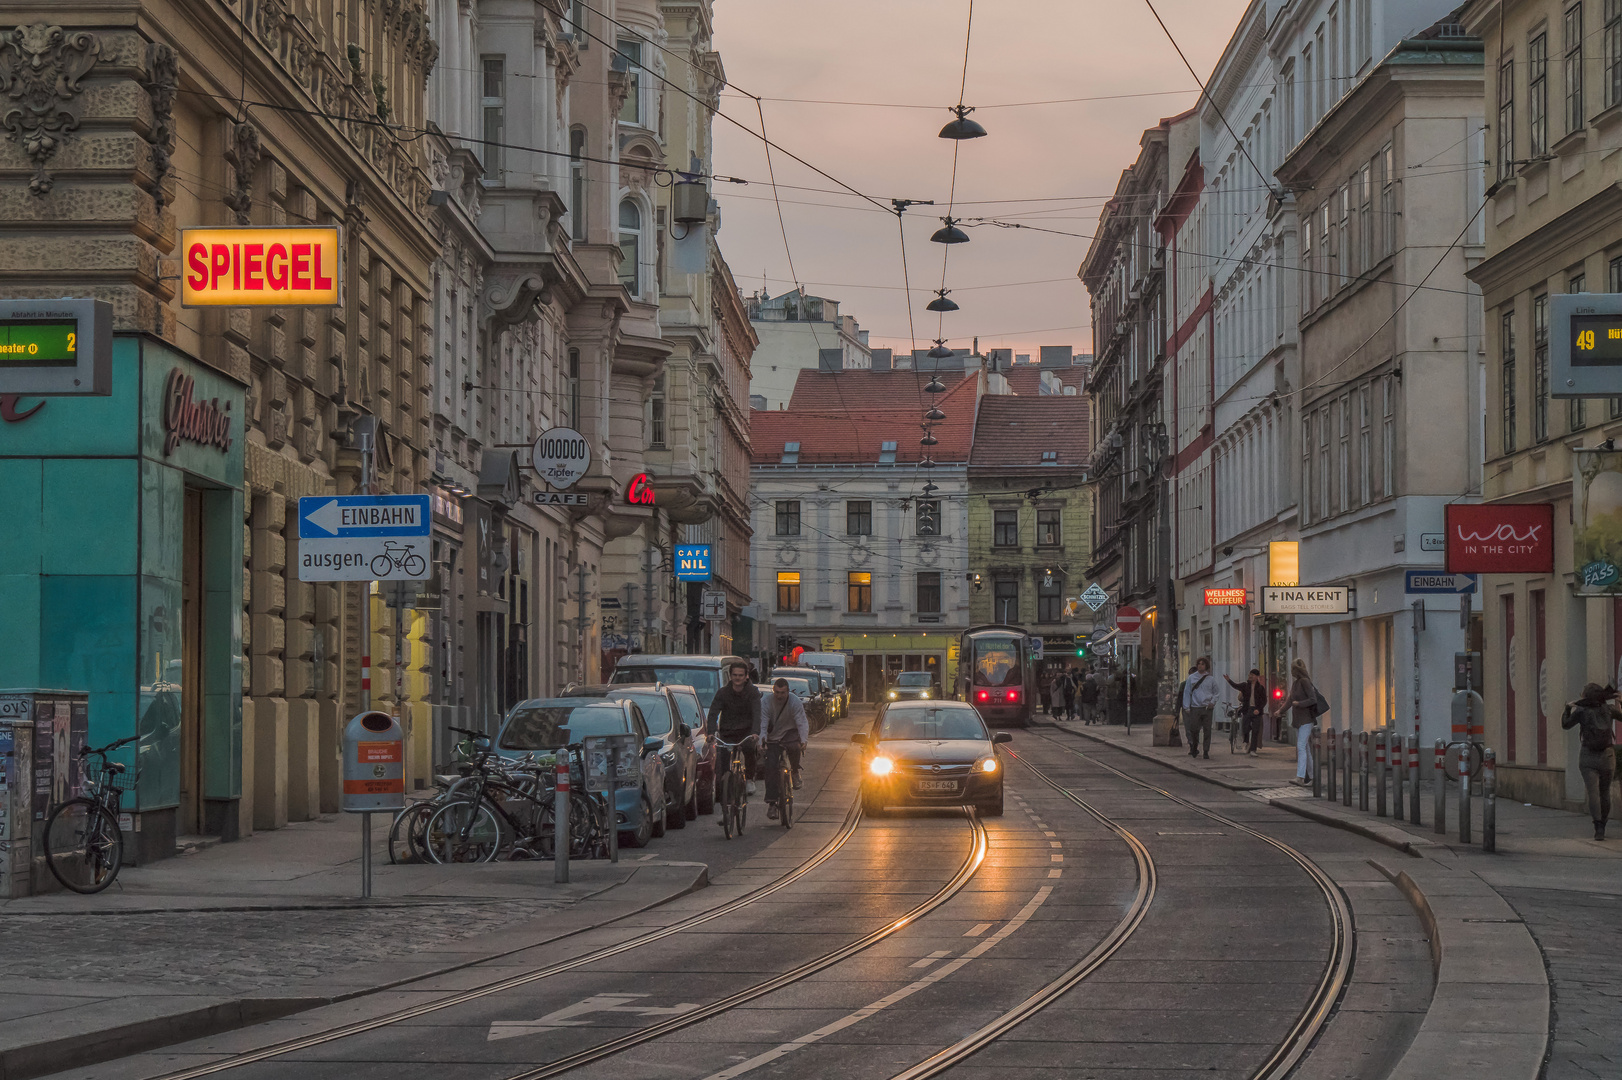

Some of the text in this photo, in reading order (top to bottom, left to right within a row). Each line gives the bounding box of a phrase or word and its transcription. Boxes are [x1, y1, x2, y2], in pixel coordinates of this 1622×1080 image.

[187, 243, 332, 291] SPIEGEL
[67, 333, 76, 352] 2
[1576, 330, 1595, 350] 49
[540, 439, 585, 459] VOODOO
[547, 467, 575, 478] Zipfer
[535, 493, 587, 504] CAFE
[341, 508, 414, 525] EINBAHN
[1458, 524, 1542, 541] wax
[303, 553, 368, 571] ausgen.
[681, 559, 706, 569] NIL
[1414, 577, 1454, 587] EINBAHN
[1585, 564, 1614, 585] FASS
[1206, 589, 1245, 597] WELLNESS
[1281, 591, 1341, 601] INA KENT
